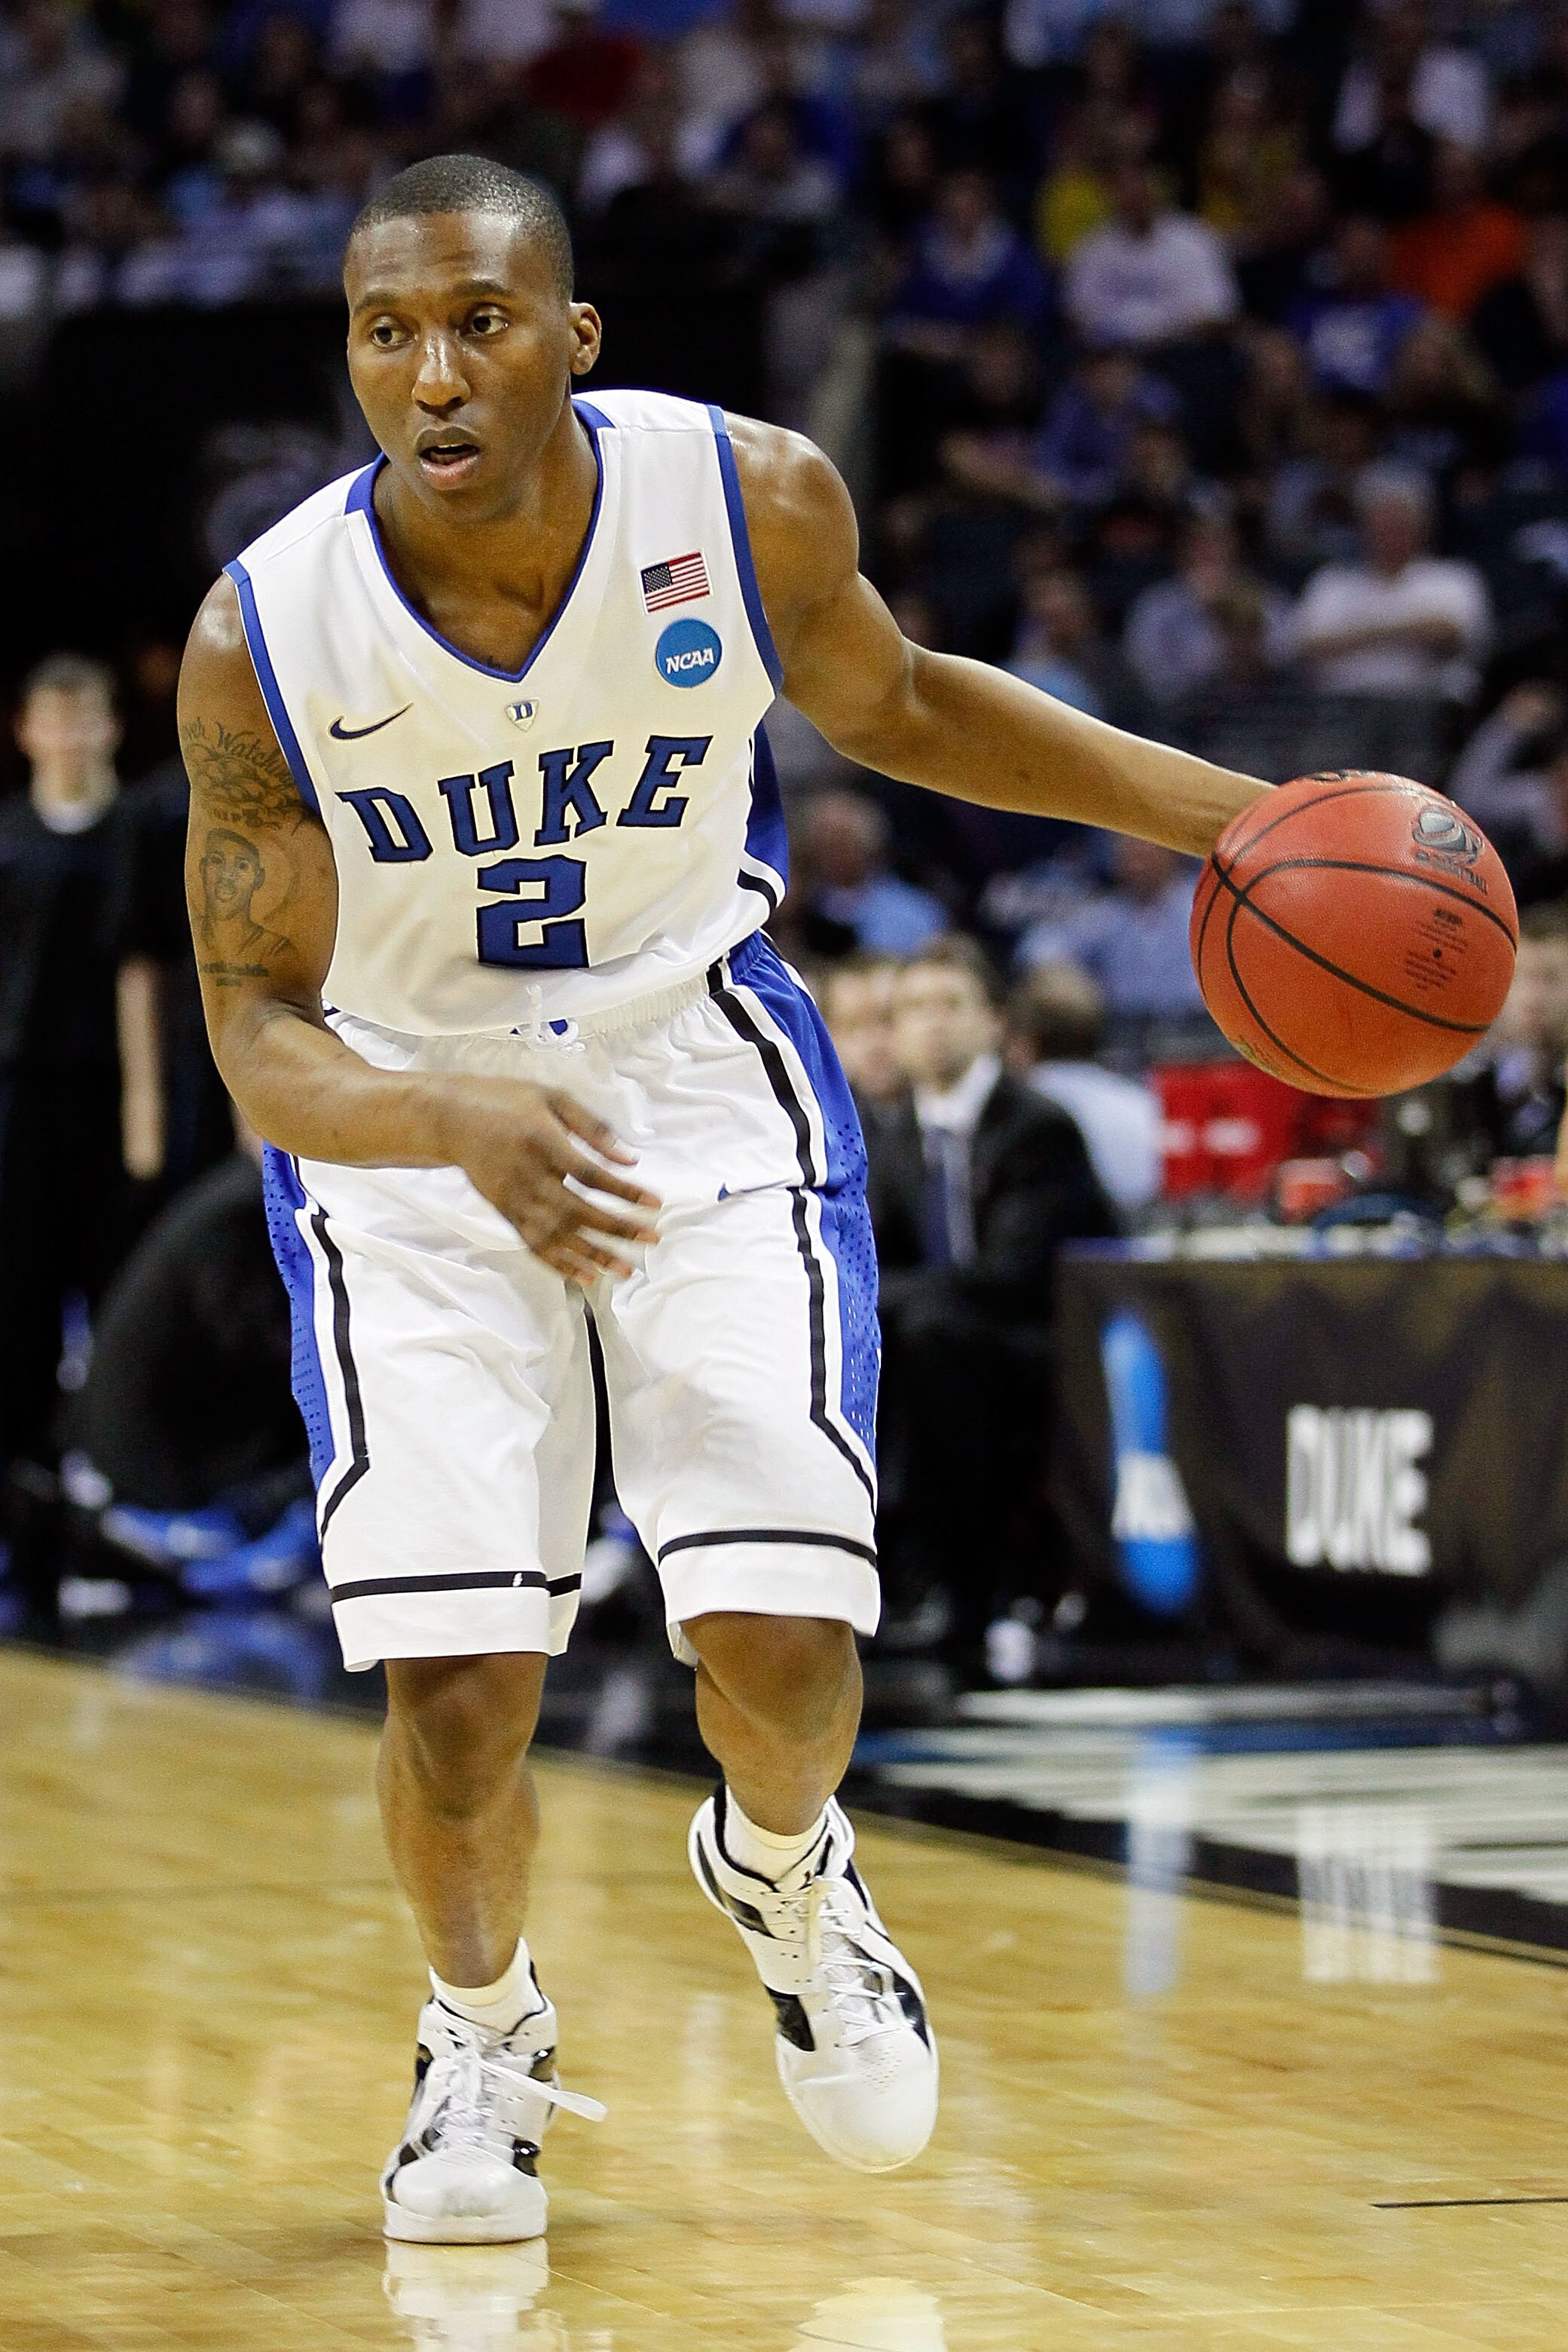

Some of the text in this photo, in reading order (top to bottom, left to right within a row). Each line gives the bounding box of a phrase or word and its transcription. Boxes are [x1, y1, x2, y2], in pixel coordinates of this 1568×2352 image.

[512, 702, 533, 721] D
[665, 647, 715, 675] NCAA
[335, 735, 714, 863] DUKE
[475, 855, 590, 969] 2
[1285, 1403, 1435, 1578] DUKE
